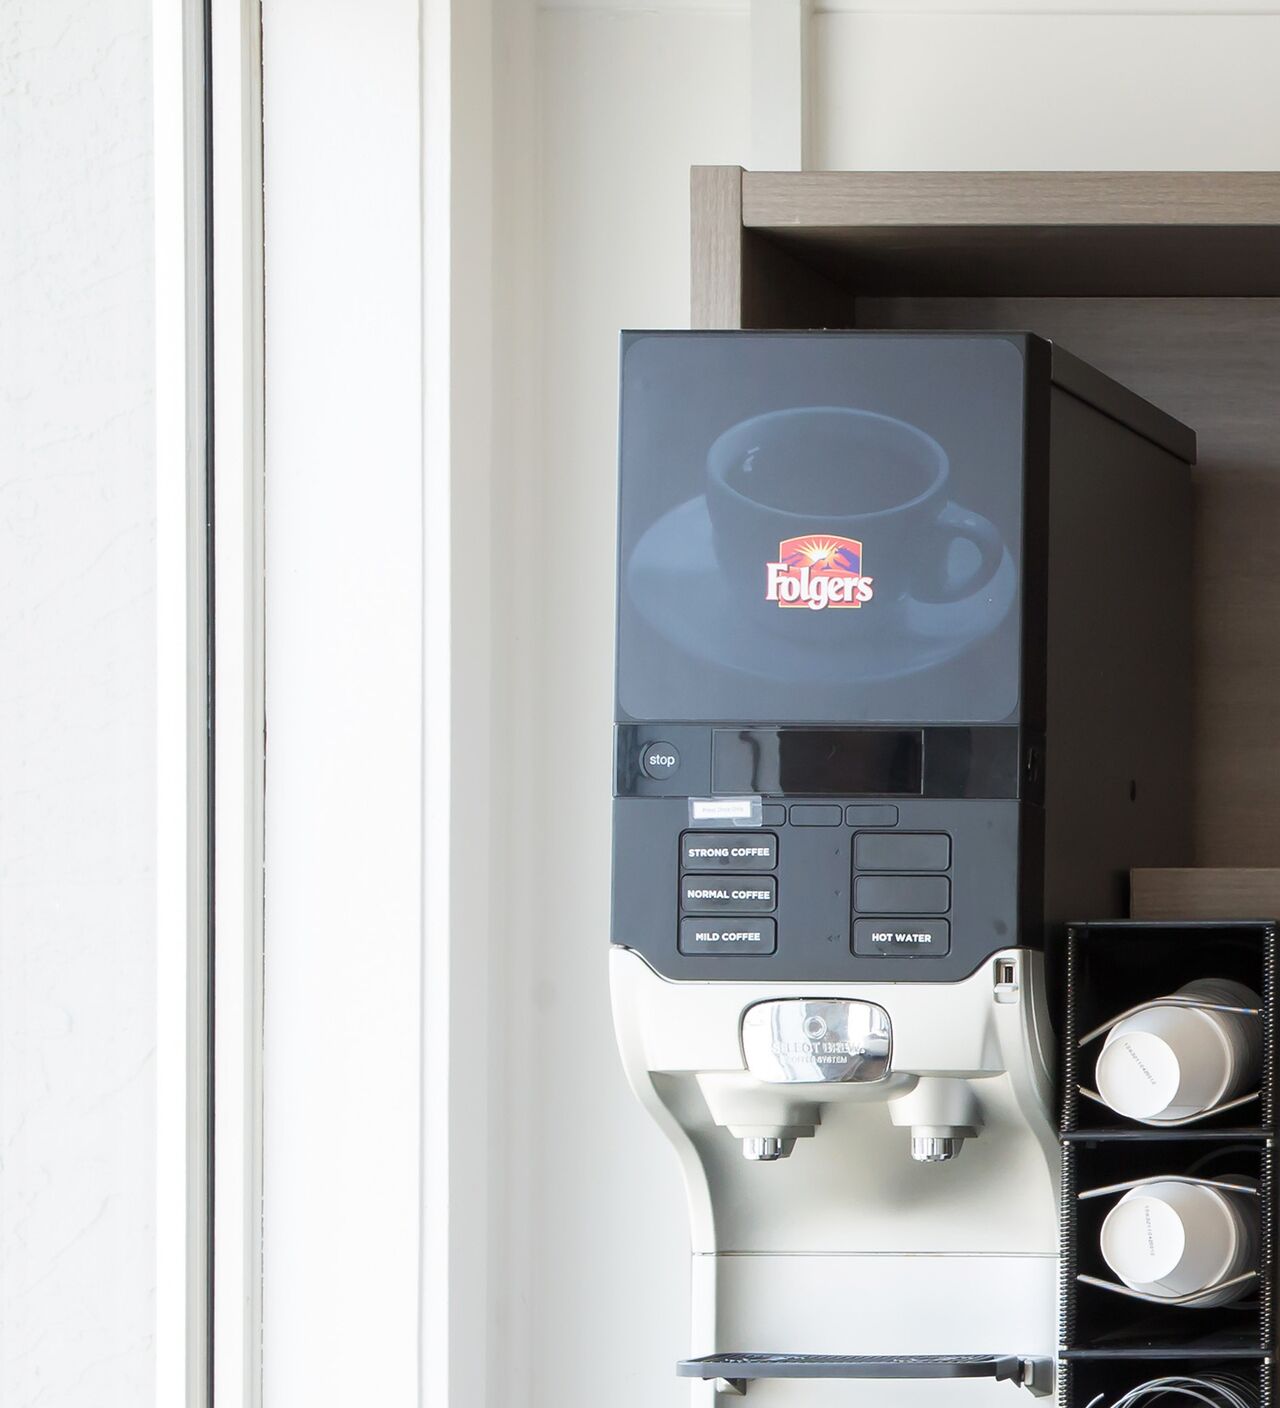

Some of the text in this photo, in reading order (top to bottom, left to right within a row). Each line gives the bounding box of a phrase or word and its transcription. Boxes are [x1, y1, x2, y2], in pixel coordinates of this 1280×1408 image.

[766, 563, 874, 610] Folgers
[649, 754, 675, 769] stop
[689, 847, 770, 858] STRONG COFFEE
[688, 889, 770, 900] NORMAL COFFEE
[696, 932, 761, 942] MILD COFFEE
[872, 933, 932, 943] HOT WATER
[816, 1056, 848, 1064] SYSTEM
